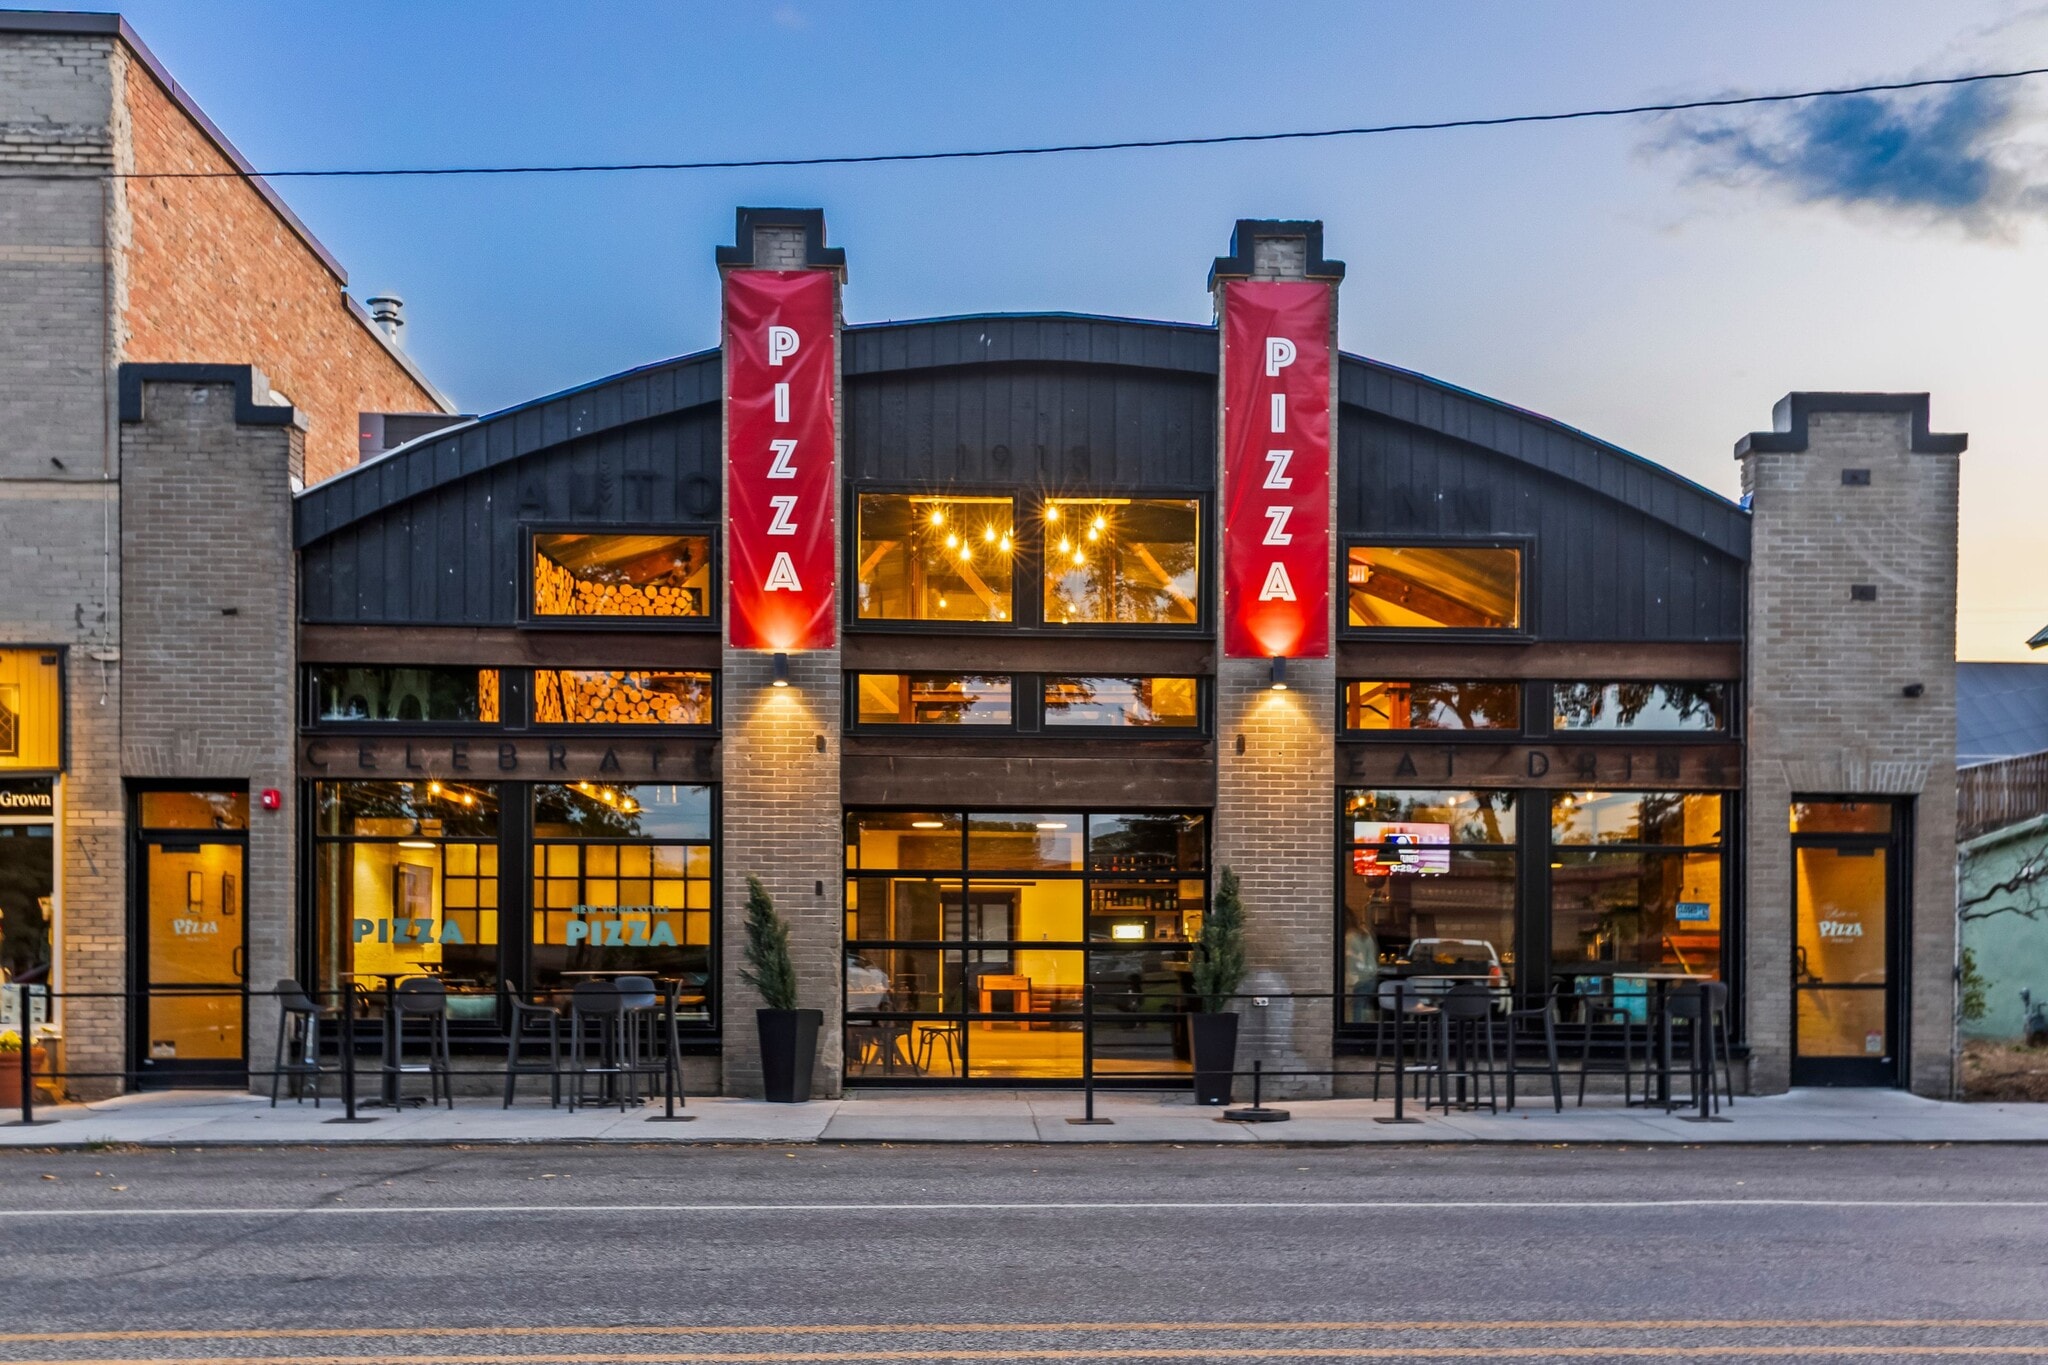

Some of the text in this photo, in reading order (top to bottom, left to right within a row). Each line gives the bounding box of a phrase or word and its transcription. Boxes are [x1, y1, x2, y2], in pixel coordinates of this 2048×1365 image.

[763, 325, 803, 592] PIZZA
[1258, 336, 1298, 602] PIZZA
[306, 741, 713, 775] CELEBRATE
[1347, 745, 1461, 778] EAT
[0, 789, 52, 808] Grown
[353, 917, 464, 944] PIZZA
[566, 919, 678, 947] PIZZA
